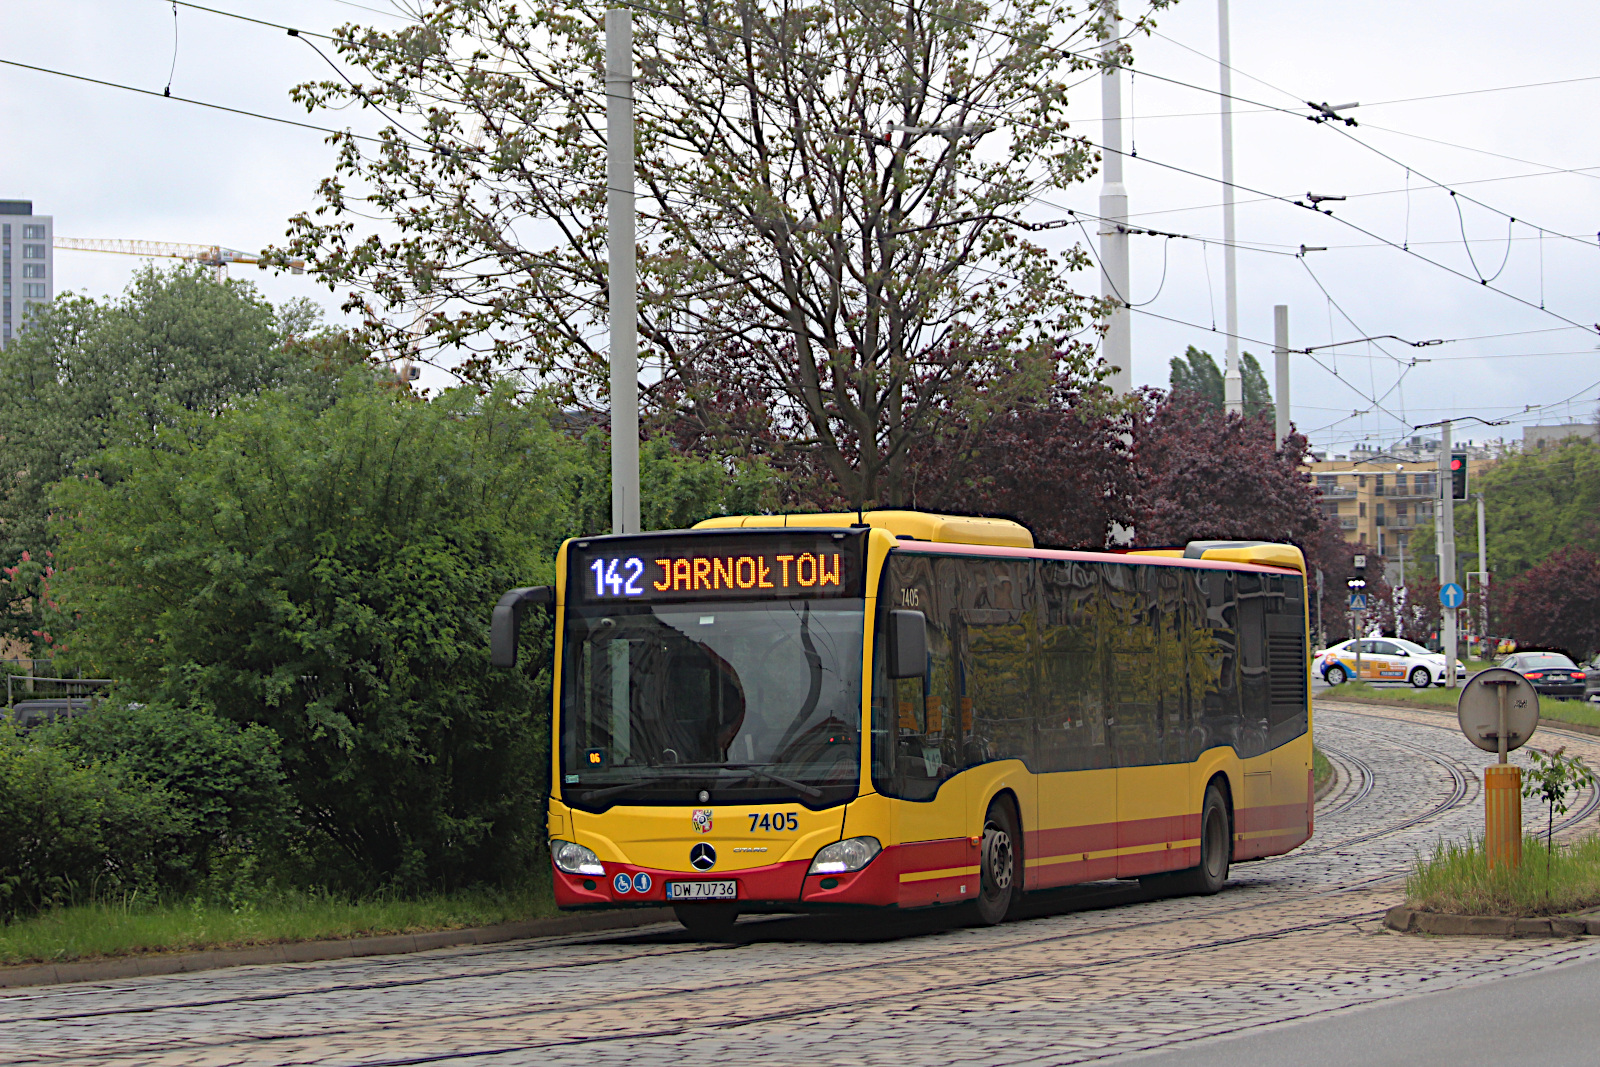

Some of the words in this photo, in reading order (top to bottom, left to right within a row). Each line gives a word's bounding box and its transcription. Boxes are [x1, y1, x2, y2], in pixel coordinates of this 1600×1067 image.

[591, 557, 644, 595] 142
[901, 588, 919, 607] 7405
[748, 812, 799, 832] 7405
[674, 883, 692, 896] DW
[695, 882, 734, 896] 7U736
